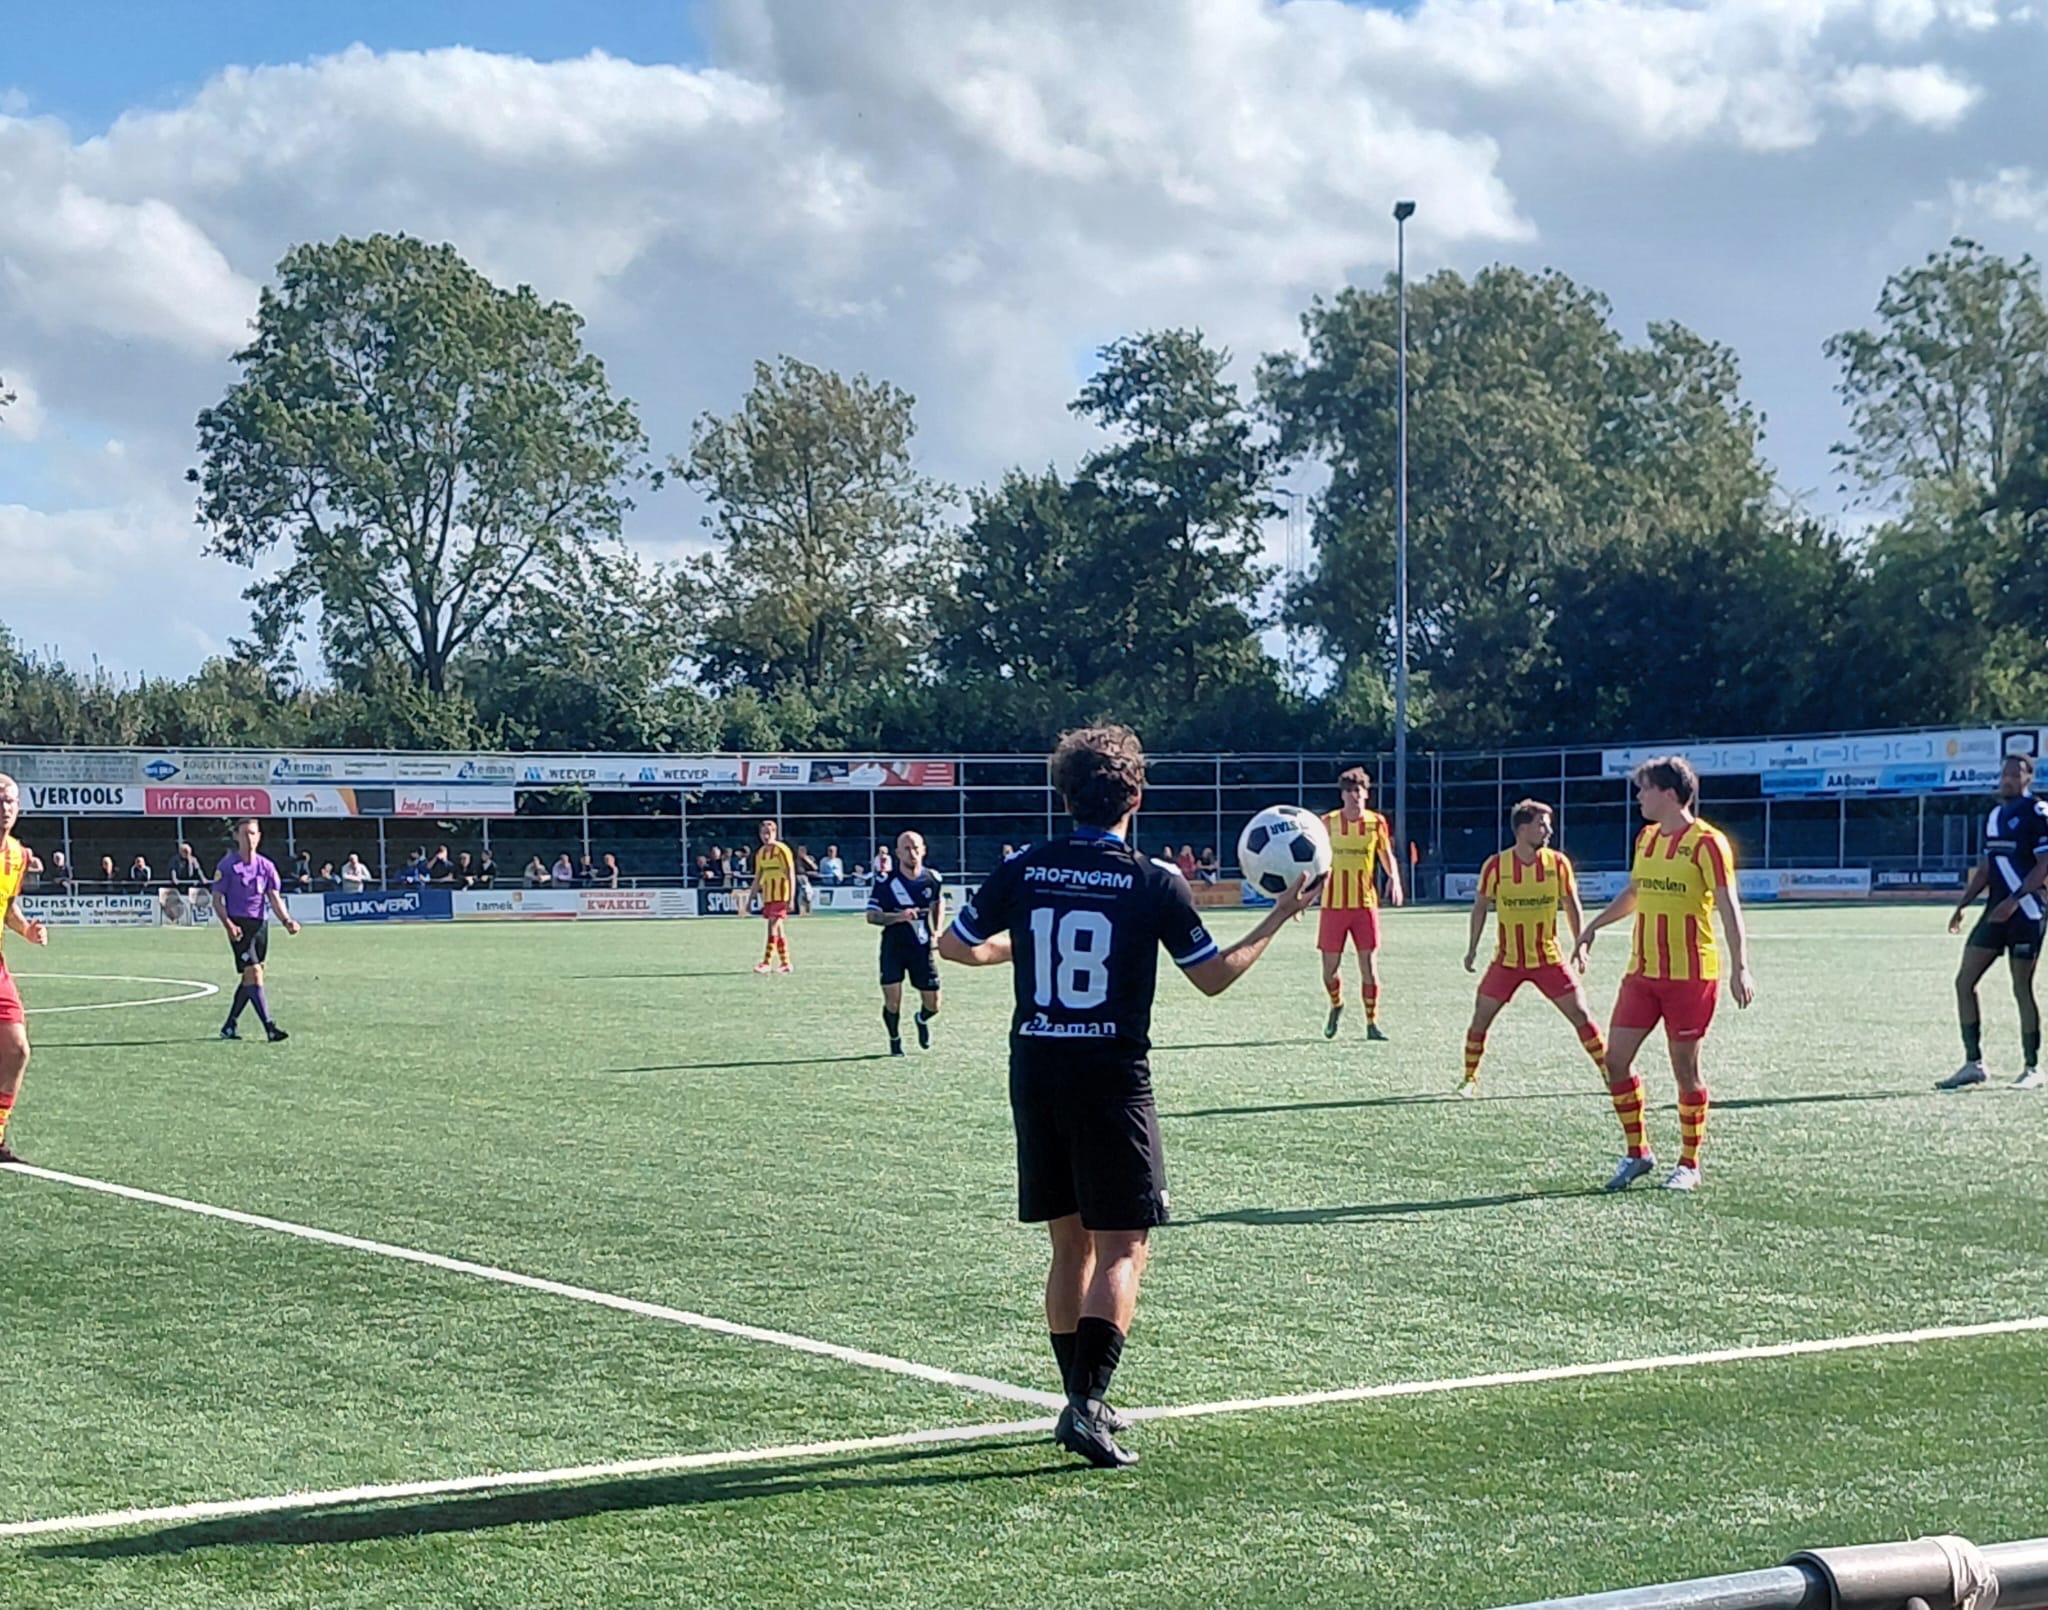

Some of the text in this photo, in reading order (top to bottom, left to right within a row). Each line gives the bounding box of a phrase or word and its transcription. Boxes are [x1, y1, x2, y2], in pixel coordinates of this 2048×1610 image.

[549, 768, 596, 780] WEEVER
[663, 768, 709, 780] WEEVER
[29, 786, 124, 808] VERTOOLS
[276, 796, 314, 813] vhm
[1024, 866, 1133, 889] PROFNORM
[22, 896, 152, 910] Dienstverlening
[587, 900, 650, 911] KWAKKEL
[1030, 907, 1113, 1010] 18
